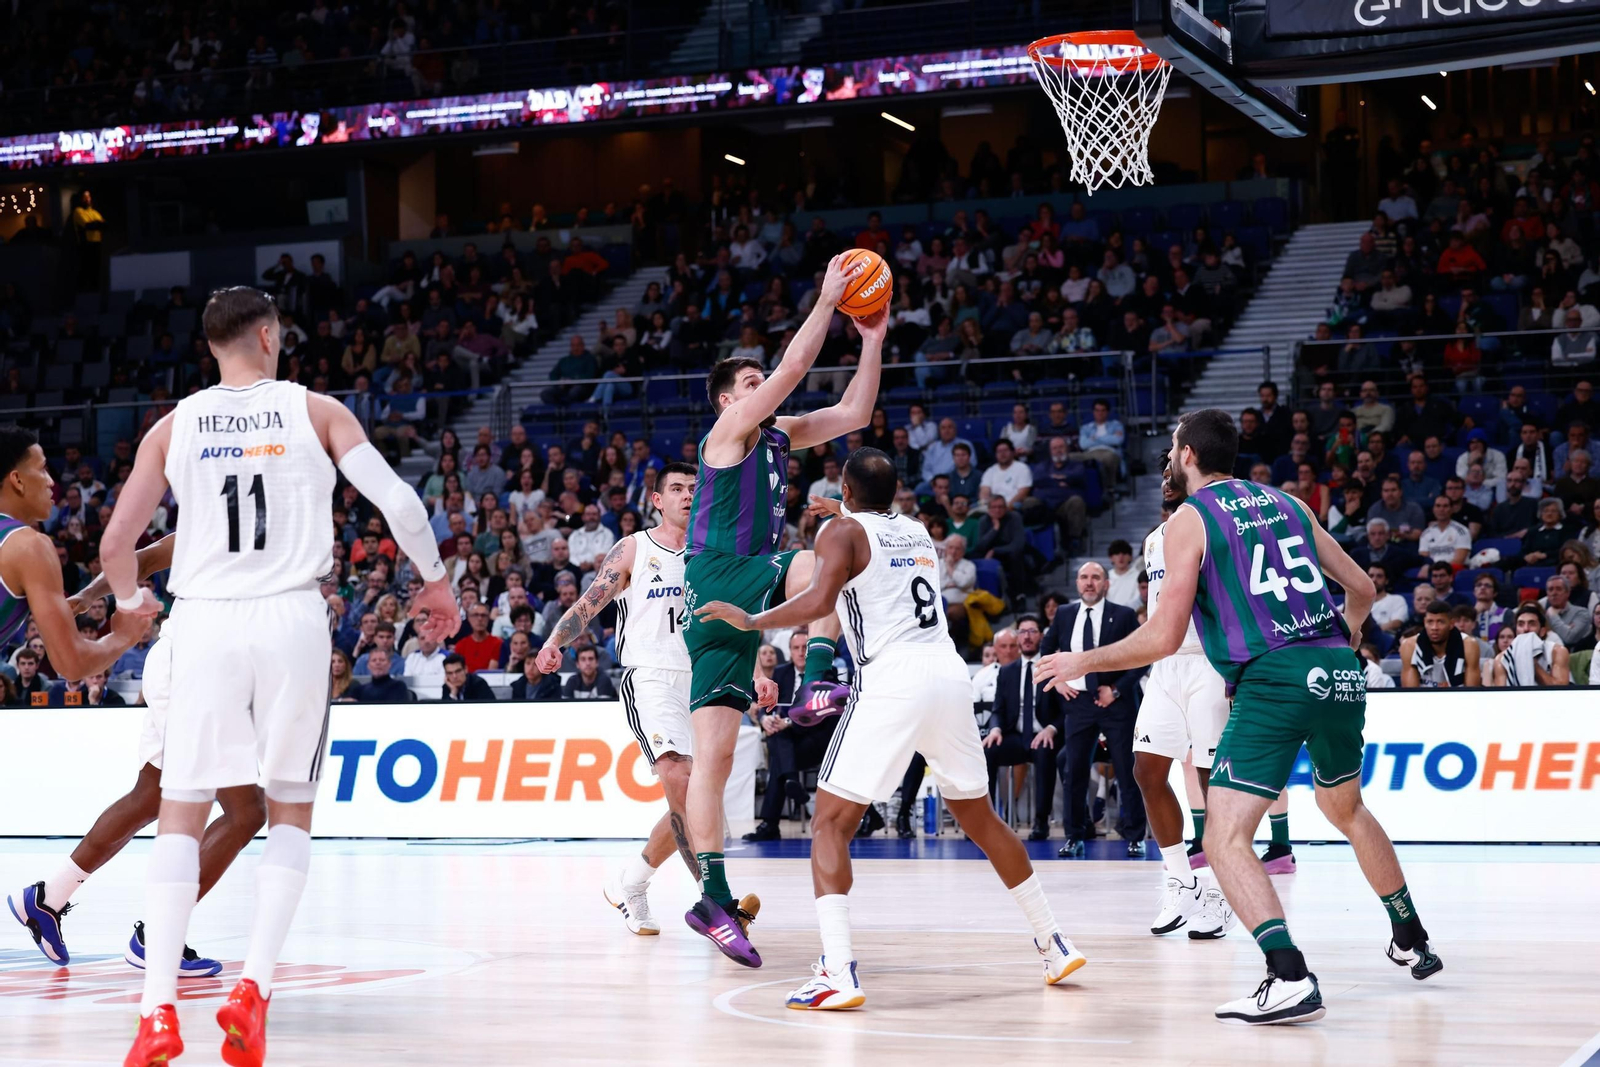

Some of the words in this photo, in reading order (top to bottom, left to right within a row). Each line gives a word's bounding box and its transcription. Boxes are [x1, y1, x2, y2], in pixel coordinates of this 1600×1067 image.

[859, 265, 891, 299] Wilson
[198, 411, 284, 433] HEZONJA
[200, 444, 286, 460] AUTOHERO
[219, 473, 268, 553] 11
[1249, 535, 1324, 602] 45
[646, 586, 684, 599] AUTO
[910, 575, 939, 629] 8
[1271, 603, 1335, 637] Andalucía
[1334, 691, 1366, 702] MÁLAG
[1335, 682, 1355, 692] DEL
[1355, 682, 1366, 692] SO
[1285, 742, 1600, 791] ATOHE
